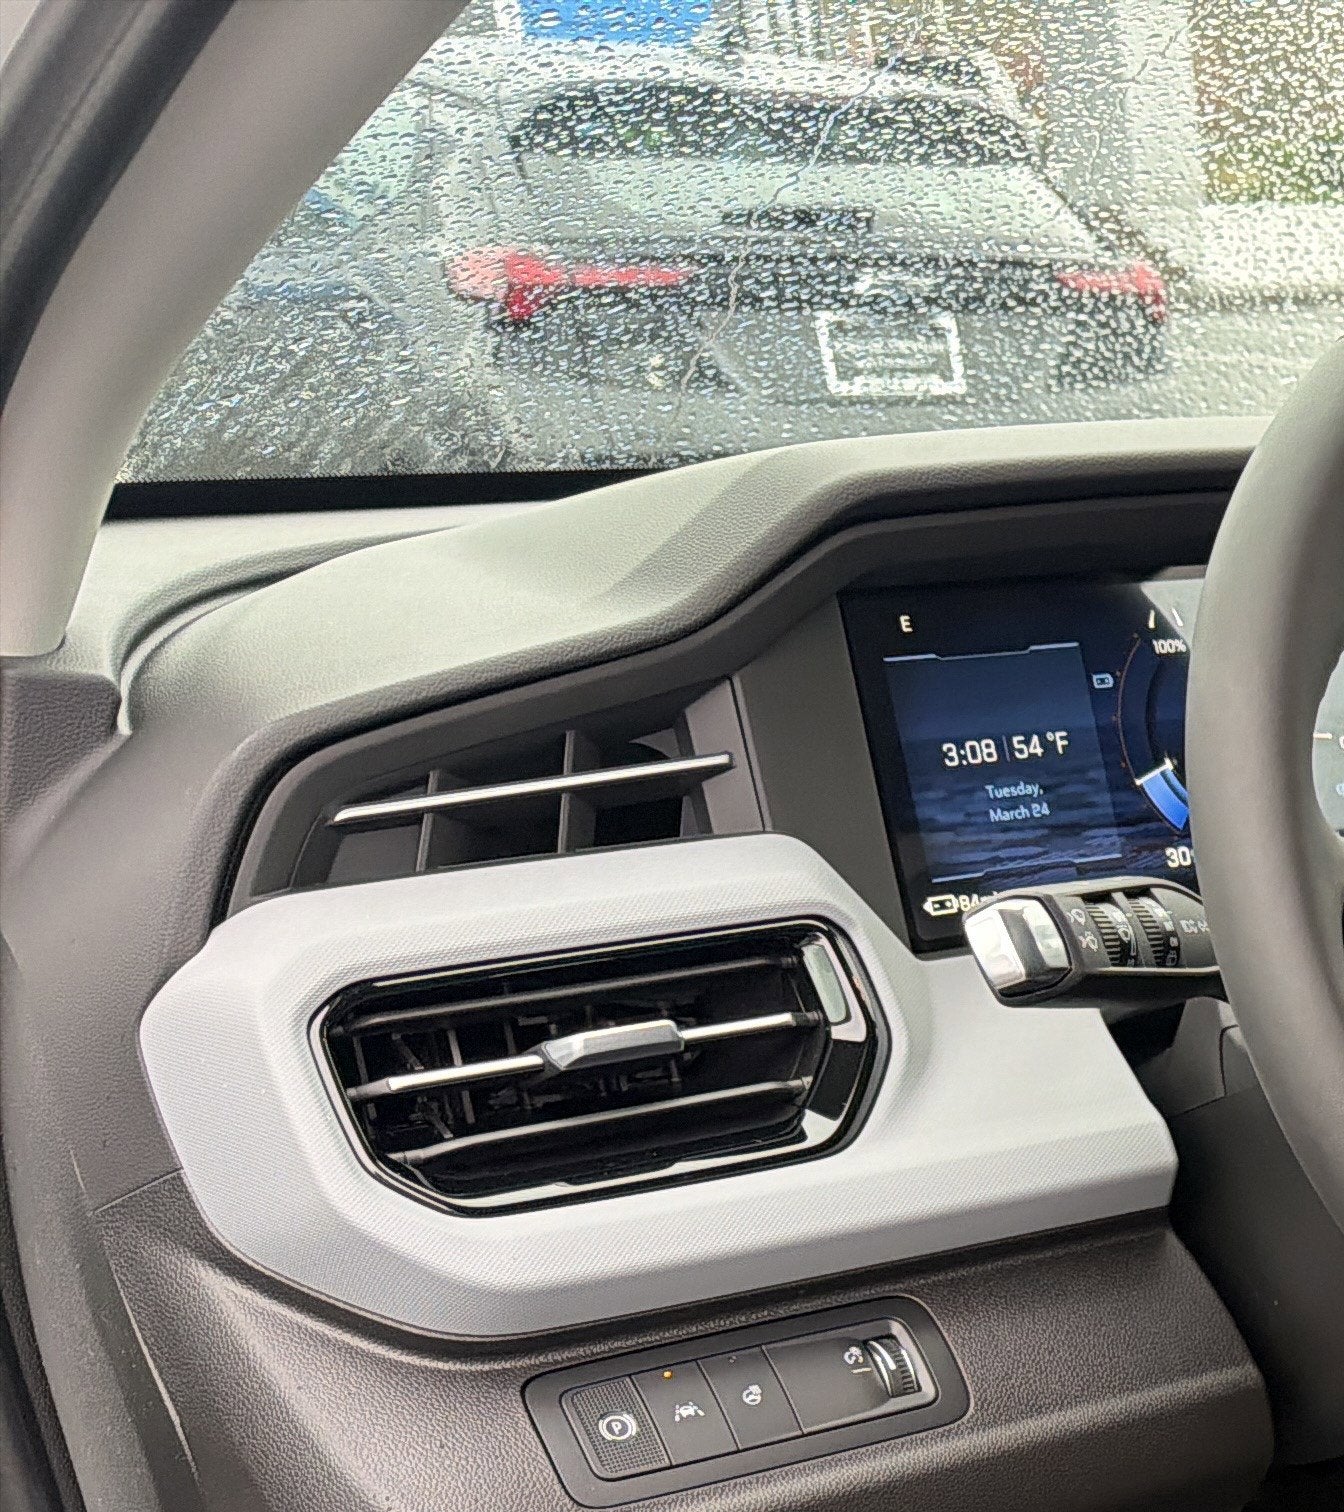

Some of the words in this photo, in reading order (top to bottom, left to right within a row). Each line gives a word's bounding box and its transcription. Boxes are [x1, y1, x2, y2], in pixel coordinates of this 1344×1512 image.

[900, 615, 913, 632] E
[1152, 639, 1187, 654] 100%
[942, 738, 998, 767] 3:08
[988, 804, 1031, 823] March
[1030, 801, 1051, 818] 24
